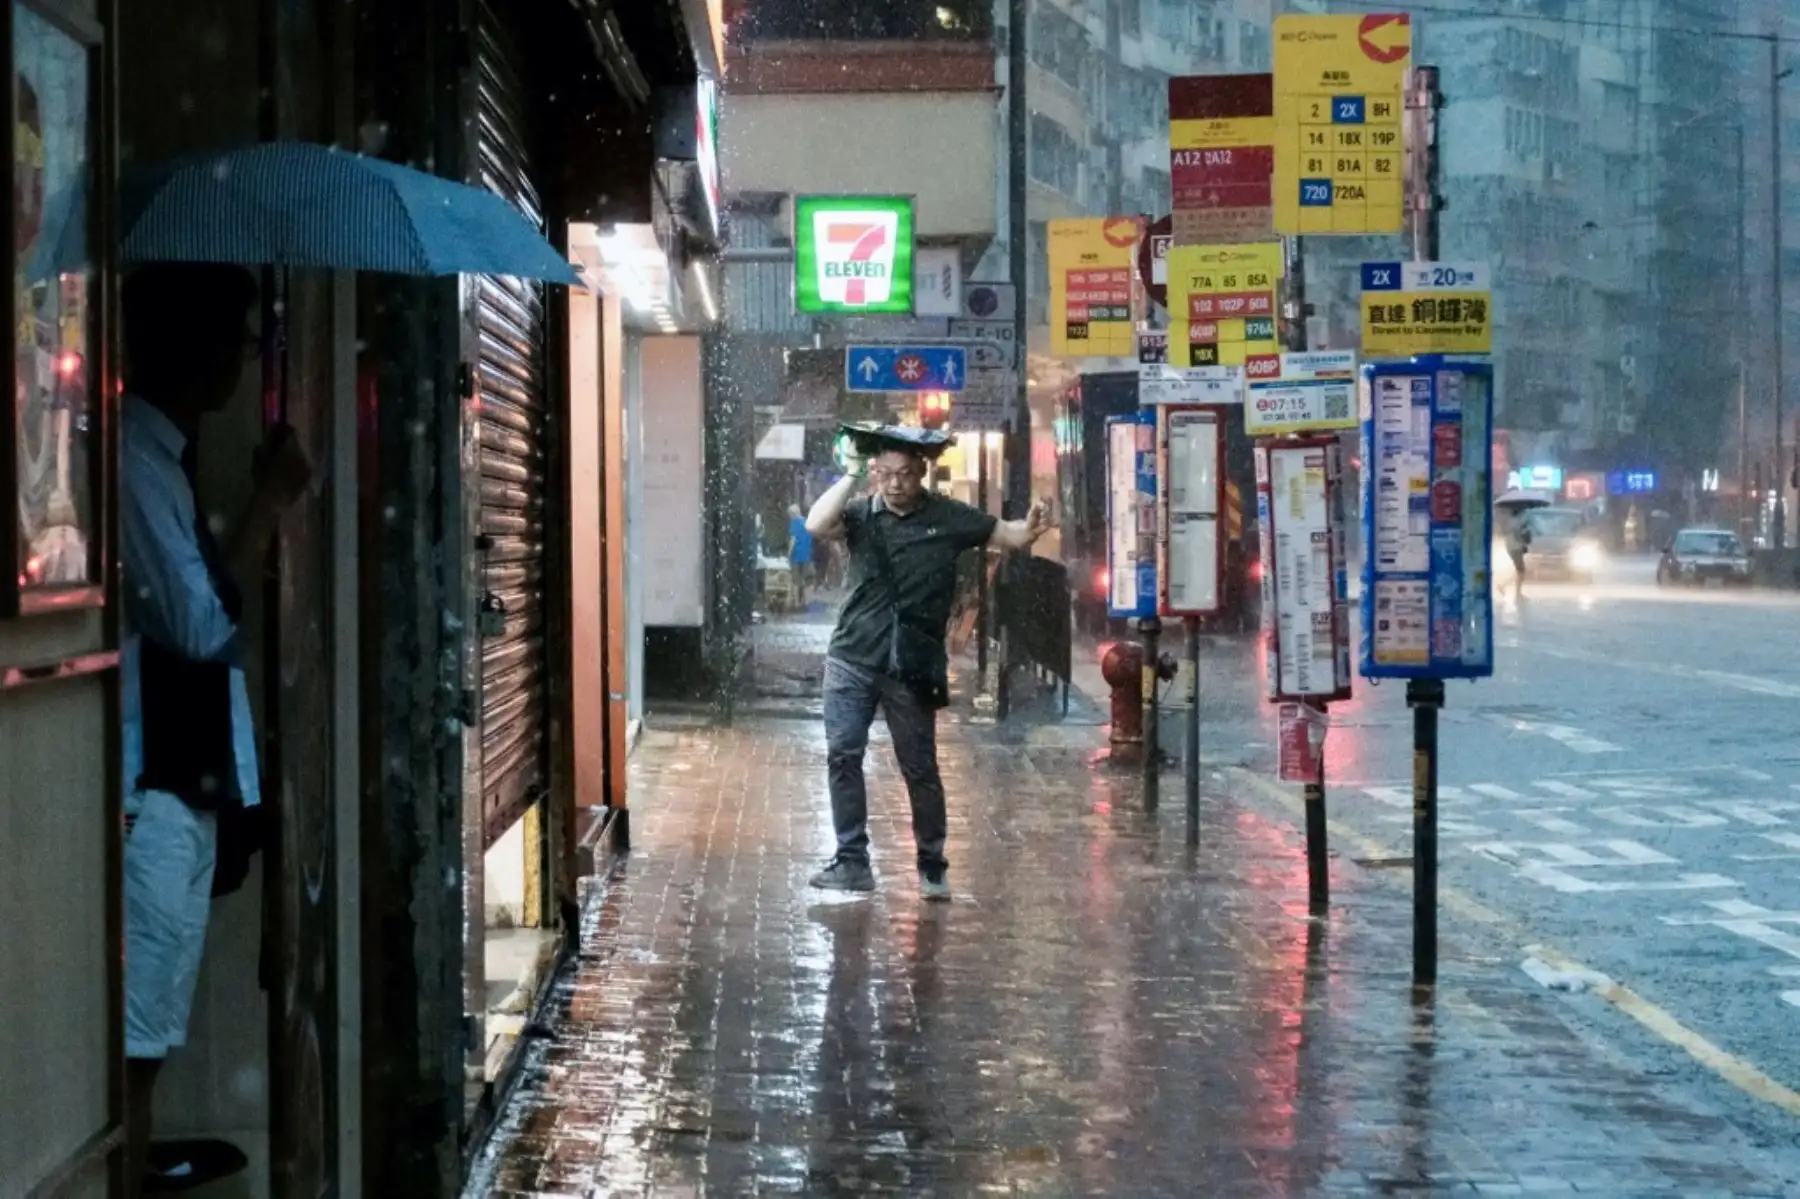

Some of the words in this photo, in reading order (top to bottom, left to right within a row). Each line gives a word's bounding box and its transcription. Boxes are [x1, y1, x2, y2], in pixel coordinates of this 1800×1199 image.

[1311, 104, 1319, 118] 2
[1340, 103, 1357, 118] 2X
[1309, 132, 1324, 145] 14
[1372, 132, 1395, 145] 19P
[1173, 152, 1200, 166] A12
[1308, 159, 1322, 172] 81
[1337, 159, 1361, 172] 81A
[1375, 159, 1391, 172] 82
[1304, 185, 1328, 199] 720
[1335, 185, 1364, 199] 720A
[828, 224, 885, 304] 7
[1192, 276, 1212, 288] 77A
[1372, 270, 1391, 285] 2X
[1368, 304, 1406, 323] 直達
[1412, 298, 1486, 323] 銅鑼灣
